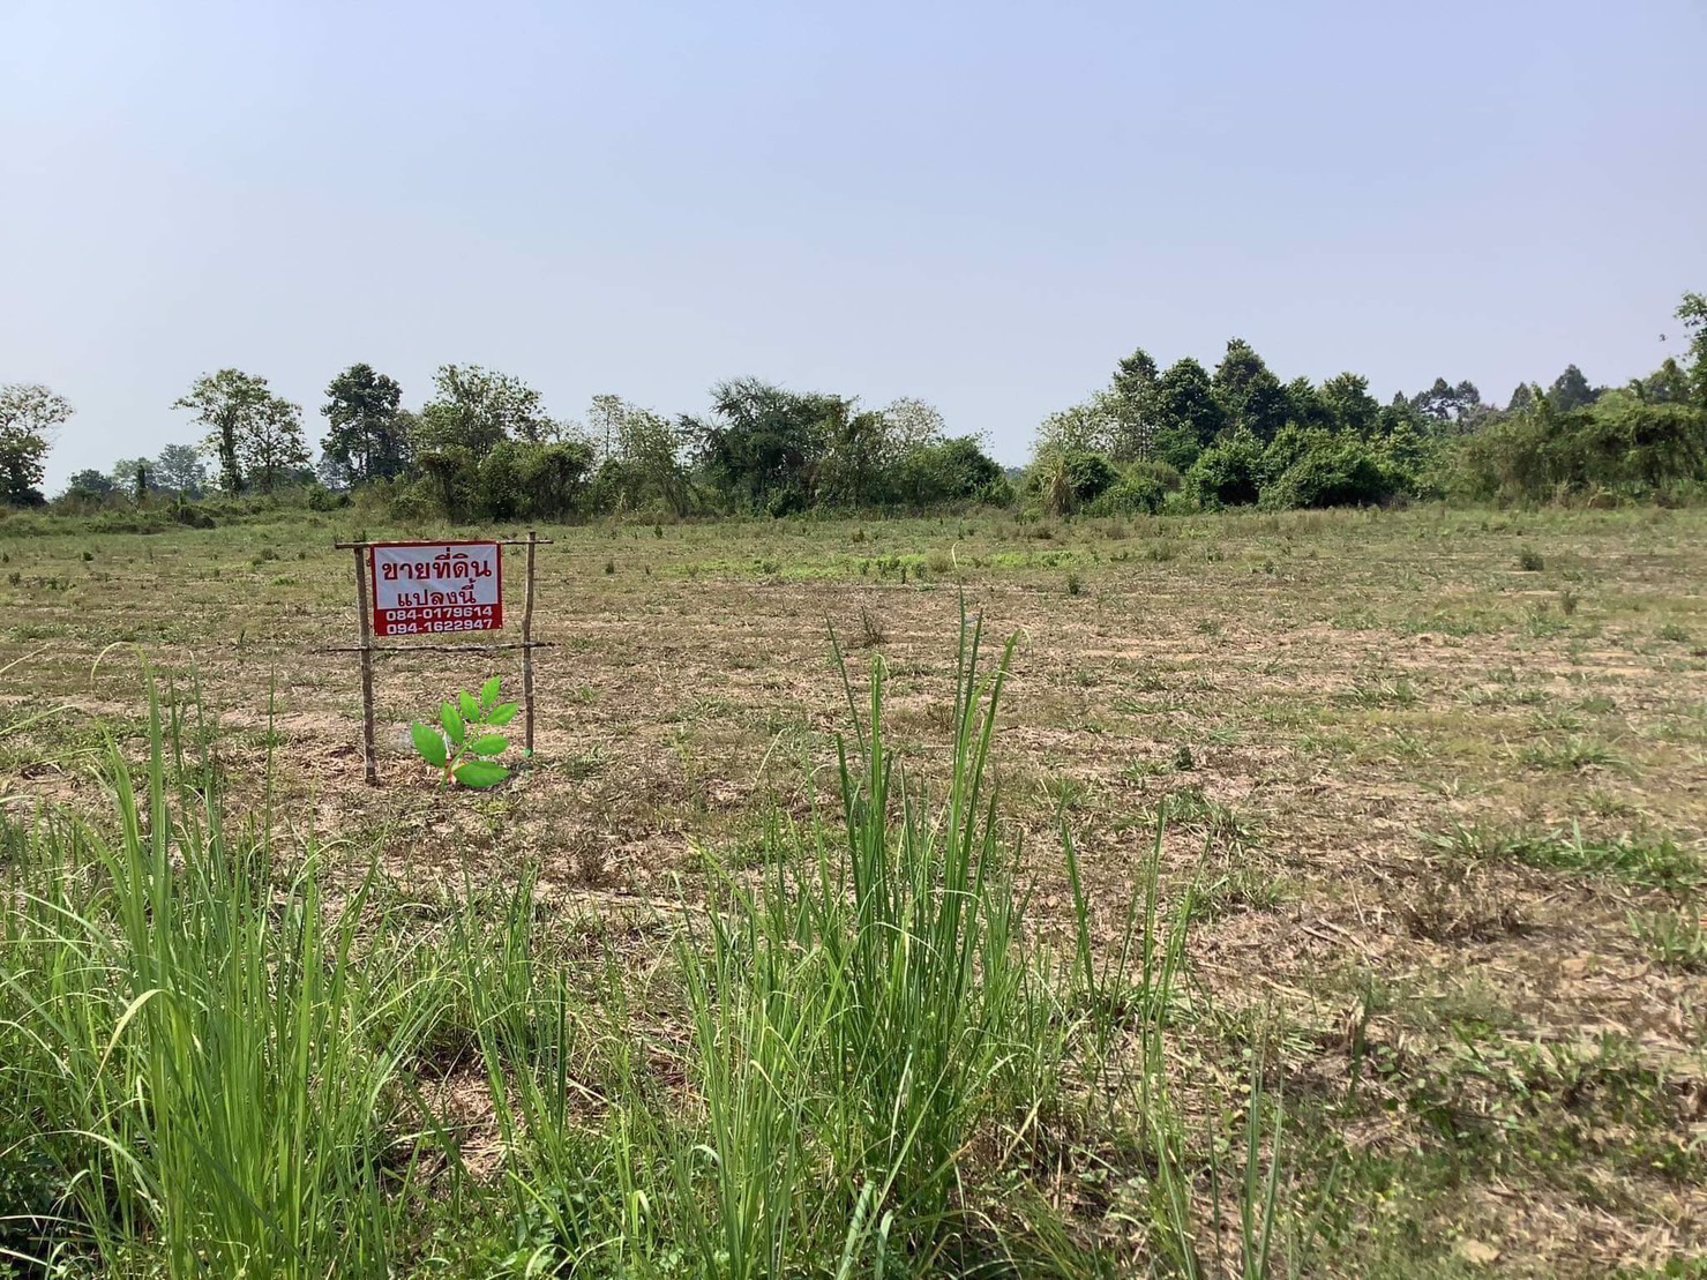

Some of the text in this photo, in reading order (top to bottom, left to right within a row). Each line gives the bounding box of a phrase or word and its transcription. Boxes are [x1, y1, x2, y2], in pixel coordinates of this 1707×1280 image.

[382, 547, 492, 580] ขายที่ดิน
[398, 578, 476, 606] แปลงนี้
[386, 606, 493, 621] 084-0179614
[386, 619, 493, 634] 094-1622947
